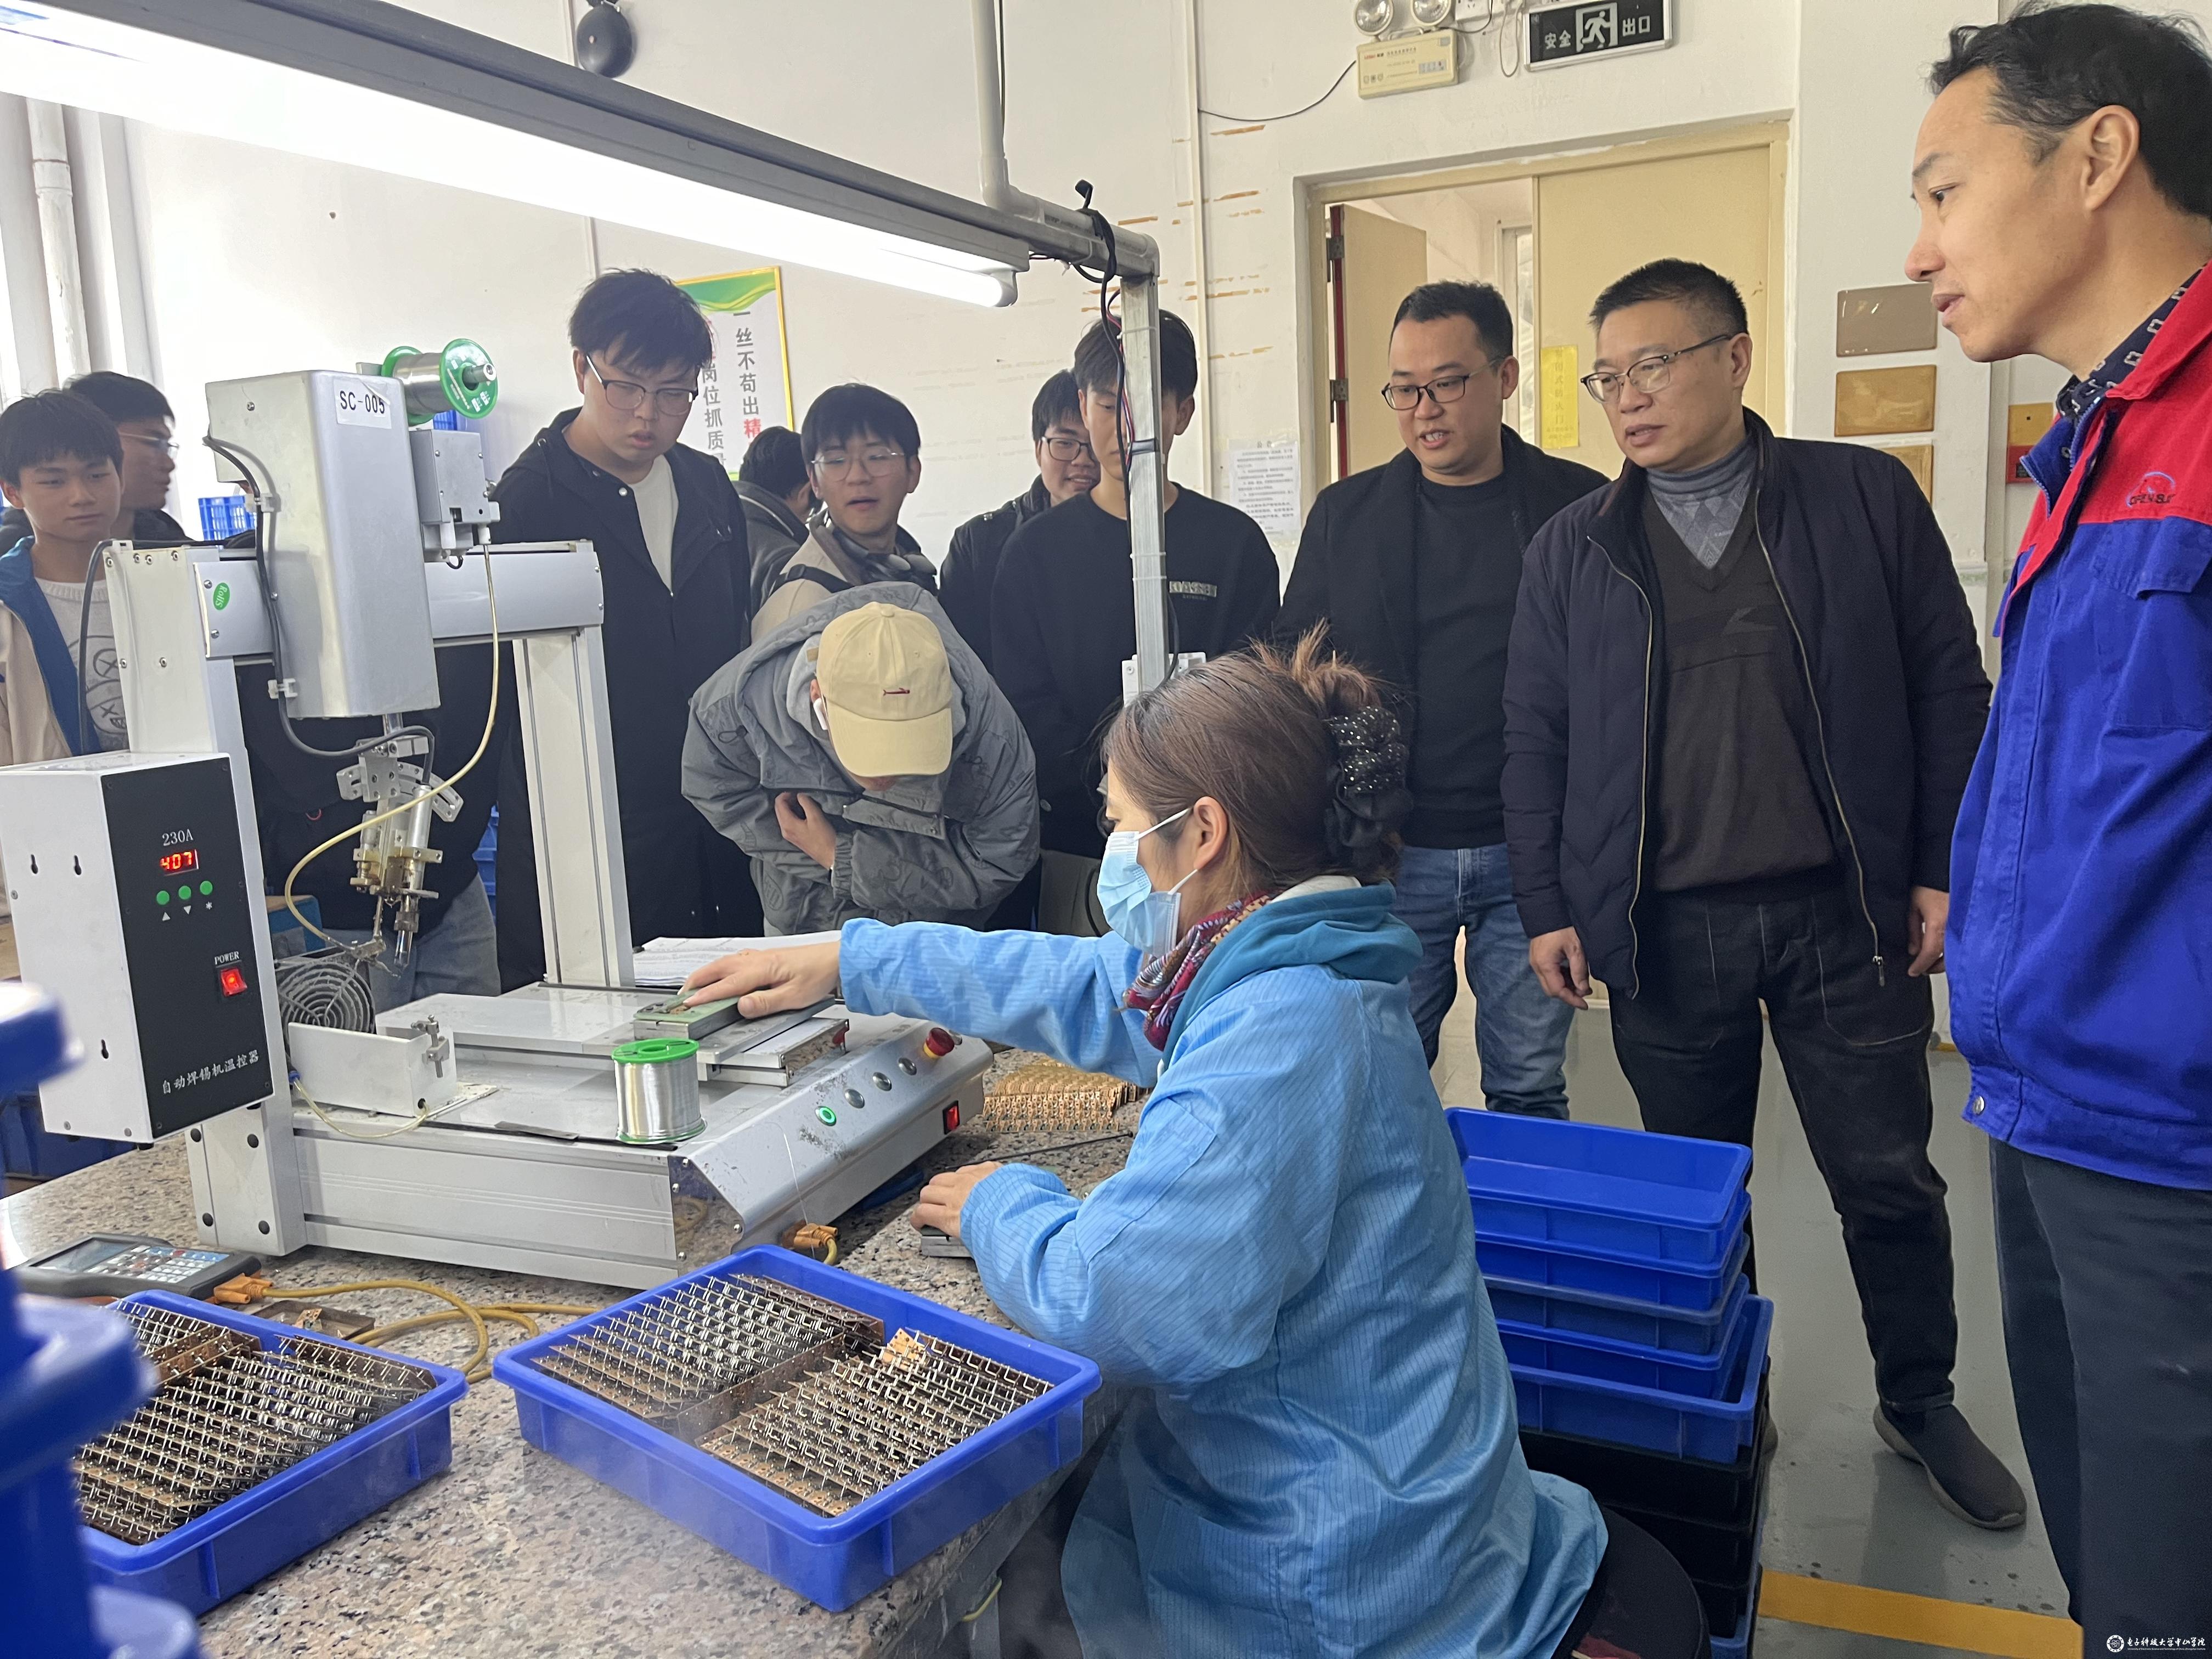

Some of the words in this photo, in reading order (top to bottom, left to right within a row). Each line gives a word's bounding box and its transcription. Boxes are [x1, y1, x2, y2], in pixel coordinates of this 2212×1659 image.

[1544, 30, 1571, 50] 安全
[1622, 15, 1650, 37] 出口
[733, 311, 761, 439] 一丝不苟出精
[340, 390, 385, 414] SC-005
[702, 320, 726, 465] 岗位抓质
[162, 828, 194, 846] 230A
[160, 851, 193, 870] 407
[215, 951, 239, 965] POWER
[162, 1049, 259, 1094] 自动焊锡机温控器
